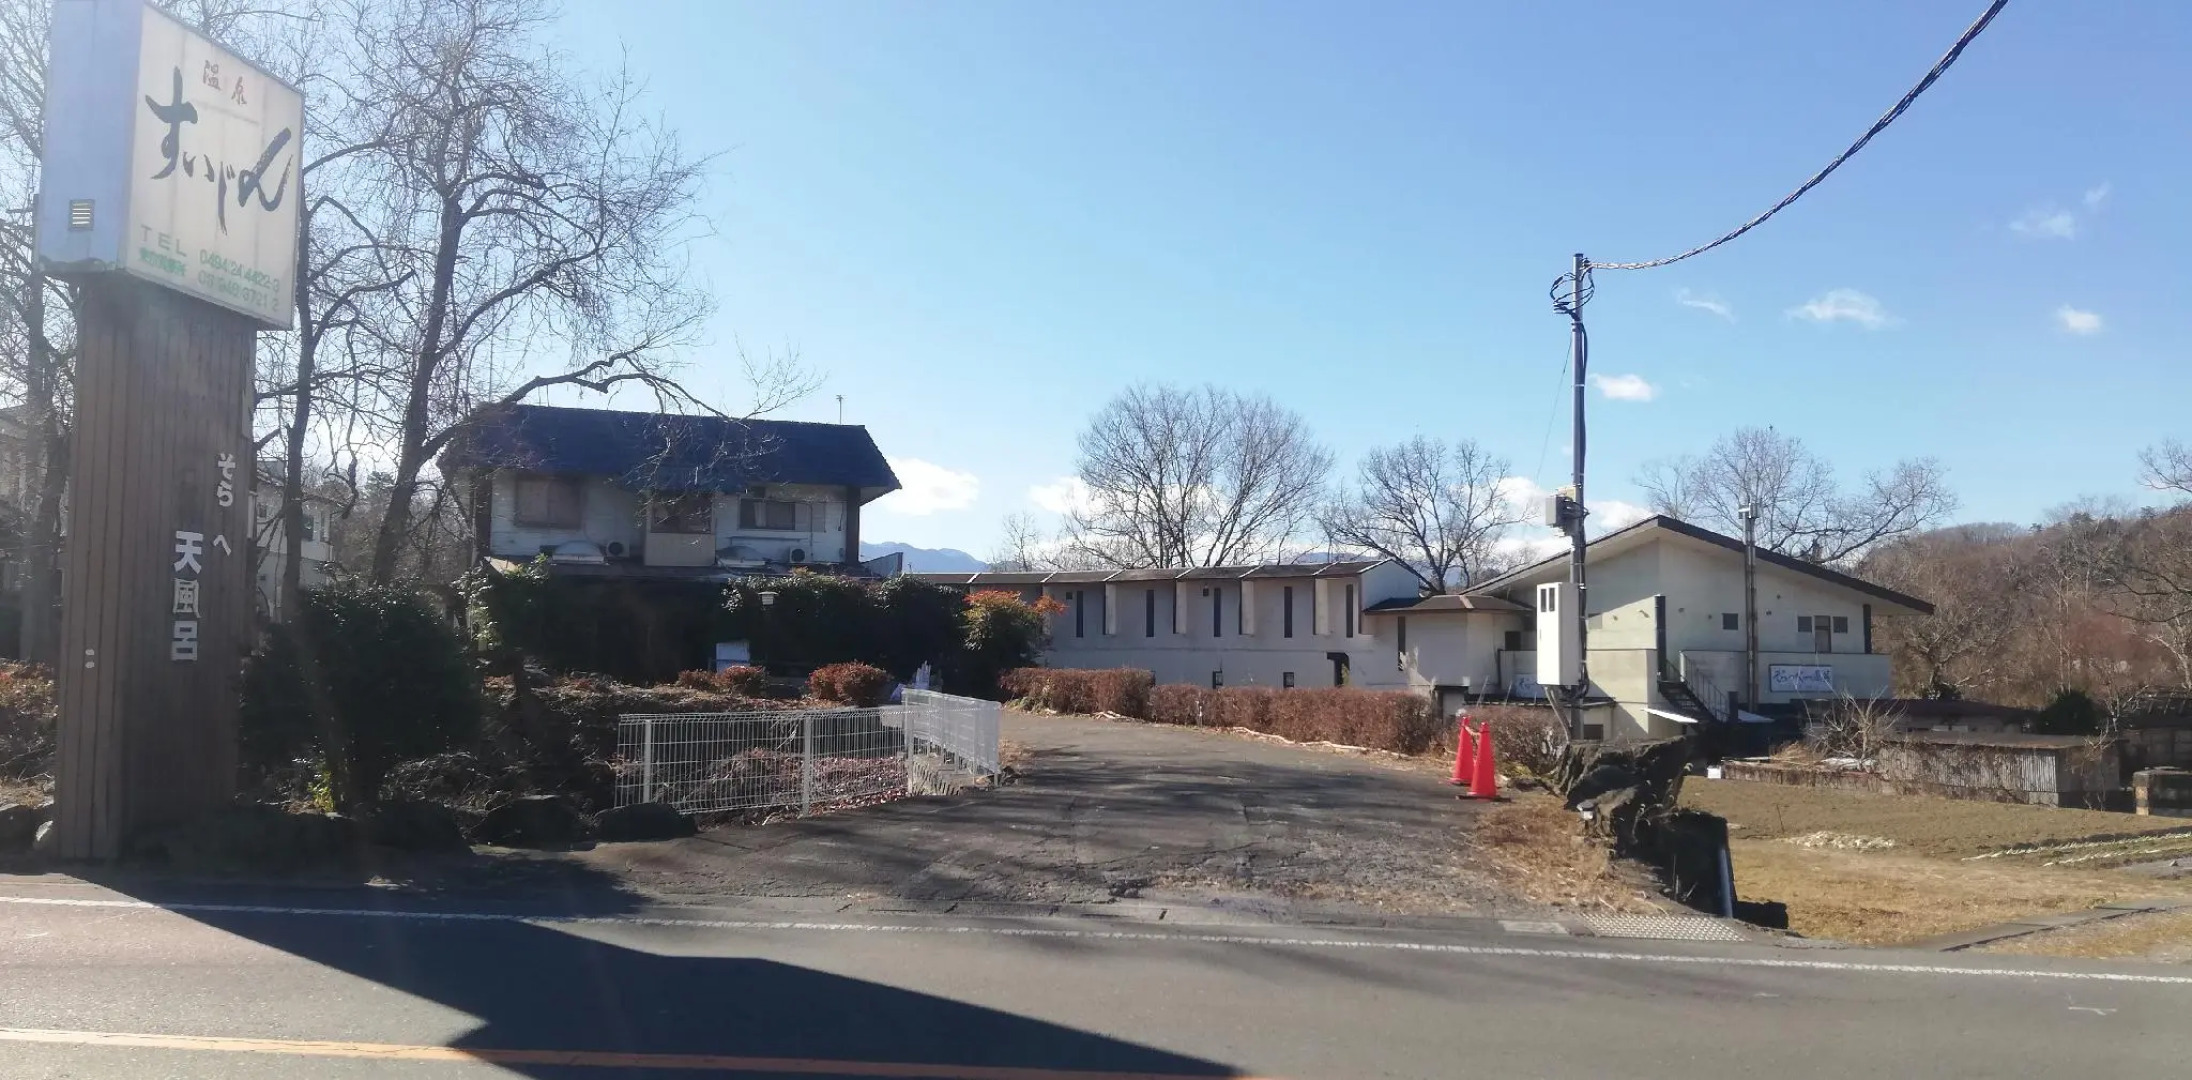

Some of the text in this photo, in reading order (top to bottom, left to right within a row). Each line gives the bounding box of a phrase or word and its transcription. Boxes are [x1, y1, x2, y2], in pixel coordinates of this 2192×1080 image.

[141, 224, 187, 257] TEL
[171, 530, 204, 661] 天風呂
